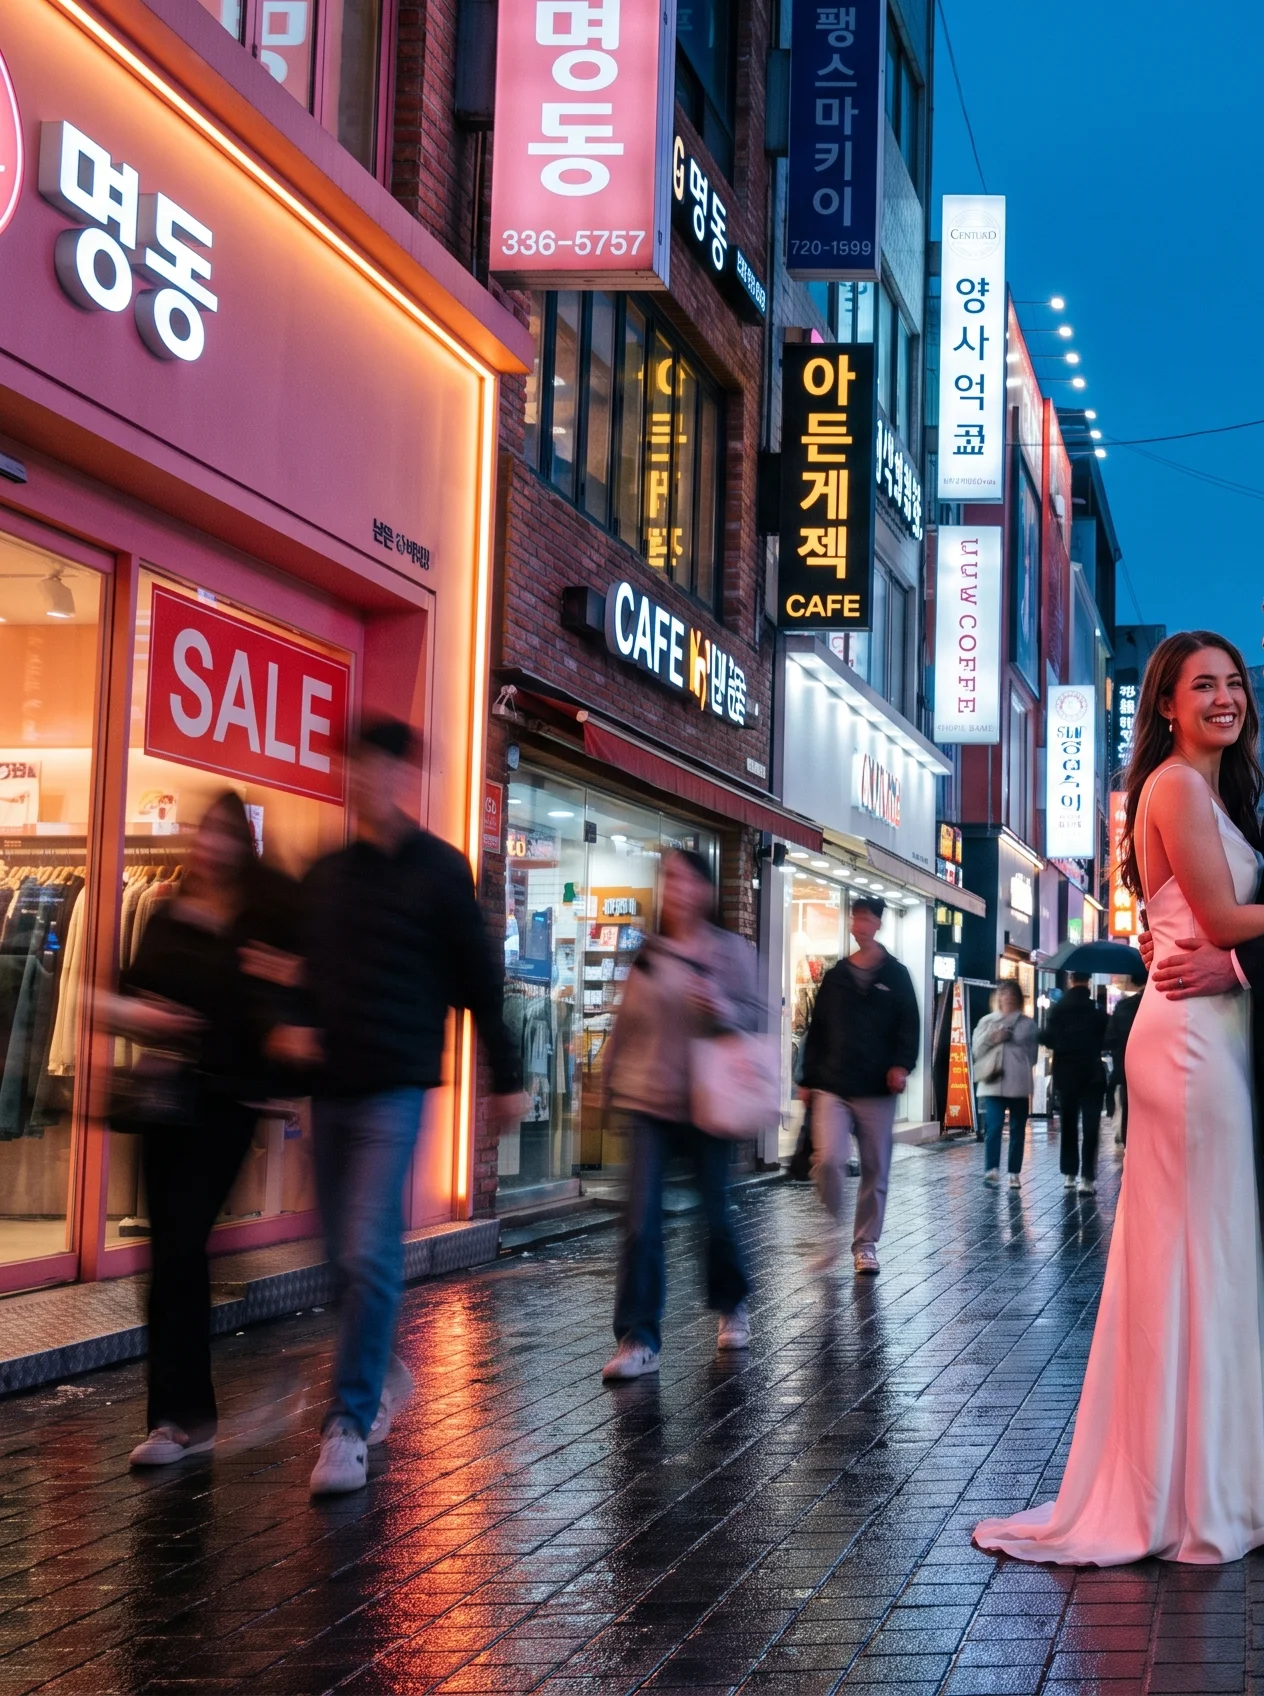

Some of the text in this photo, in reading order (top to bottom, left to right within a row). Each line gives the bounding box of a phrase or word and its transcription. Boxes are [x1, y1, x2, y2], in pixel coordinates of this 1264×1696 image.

[527, 0, 624, 197] 명동
[60, 120, 218, 362] 명동
[501, 230, 646, 256] 336-5757
[689, 157, 728, 271] 명동
[615, 581, 685, 688] CAFE
[786, 594, 860, 618] CAFE
[169, 627, 333, 774] SALE
